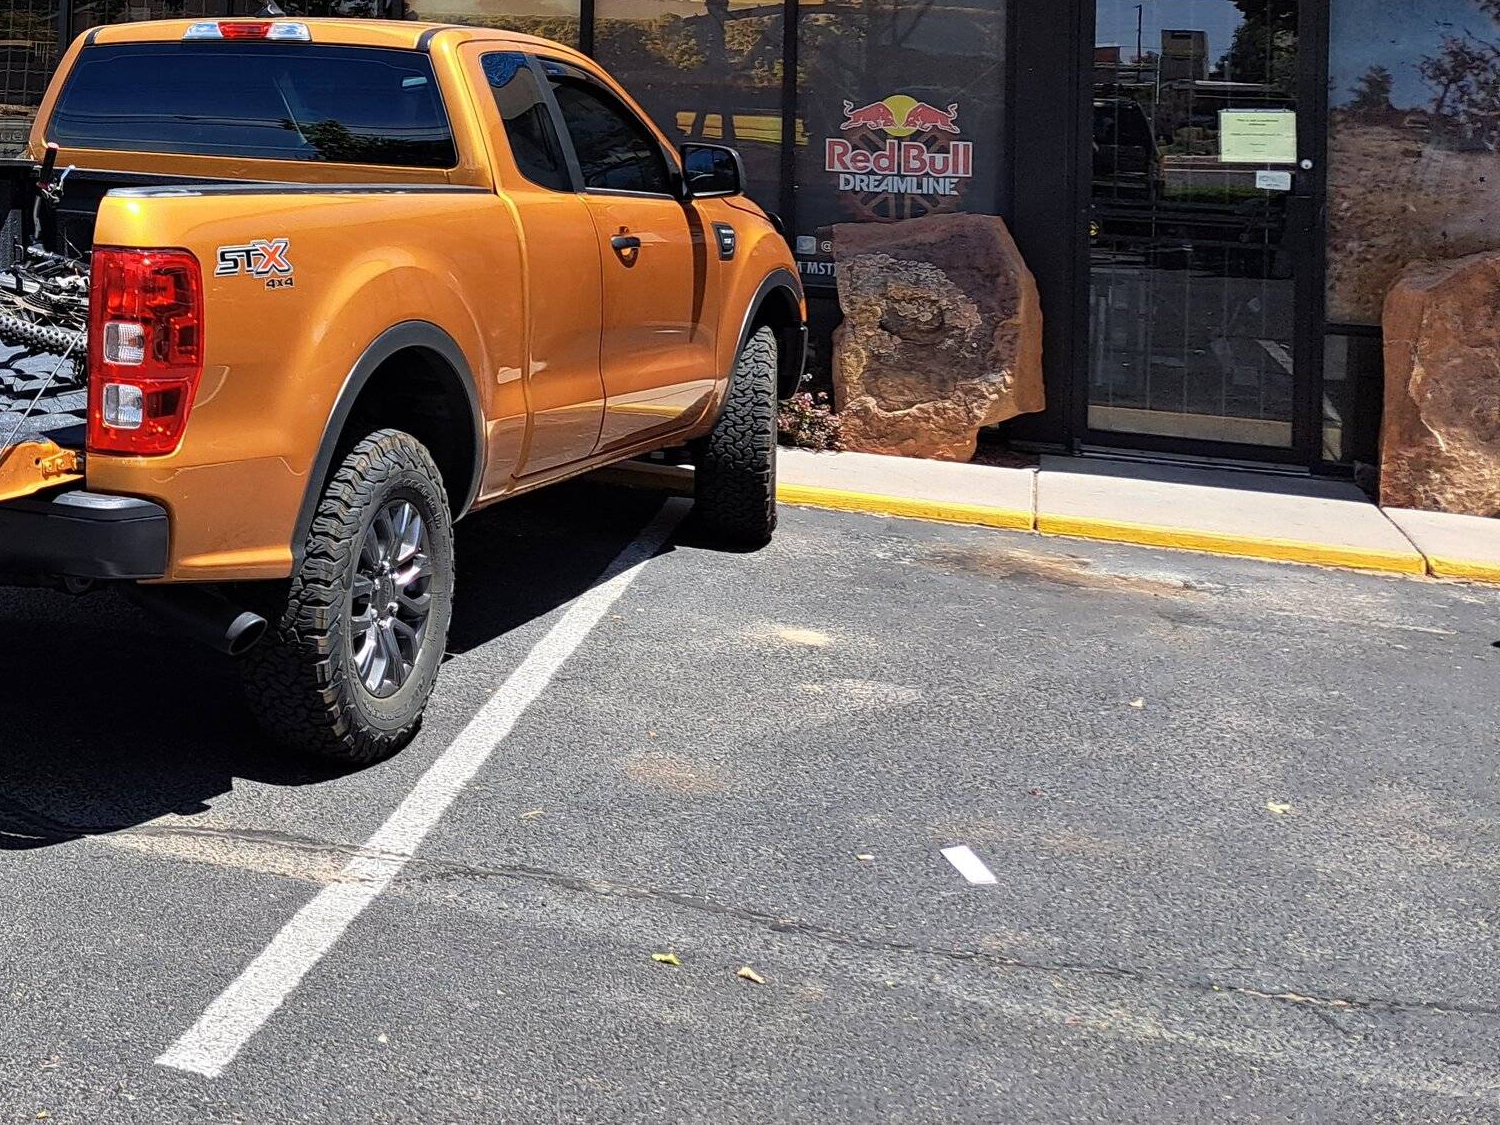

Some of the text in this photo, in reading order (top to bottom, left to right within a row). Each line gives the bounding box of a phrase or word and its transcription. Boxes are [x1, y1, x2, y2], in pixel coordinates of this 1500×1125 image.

[825, 138, 973, 177] Red Bull
[839, 174, 960, 196] DREAMLINE
[215, 239, 293, 277] STX
